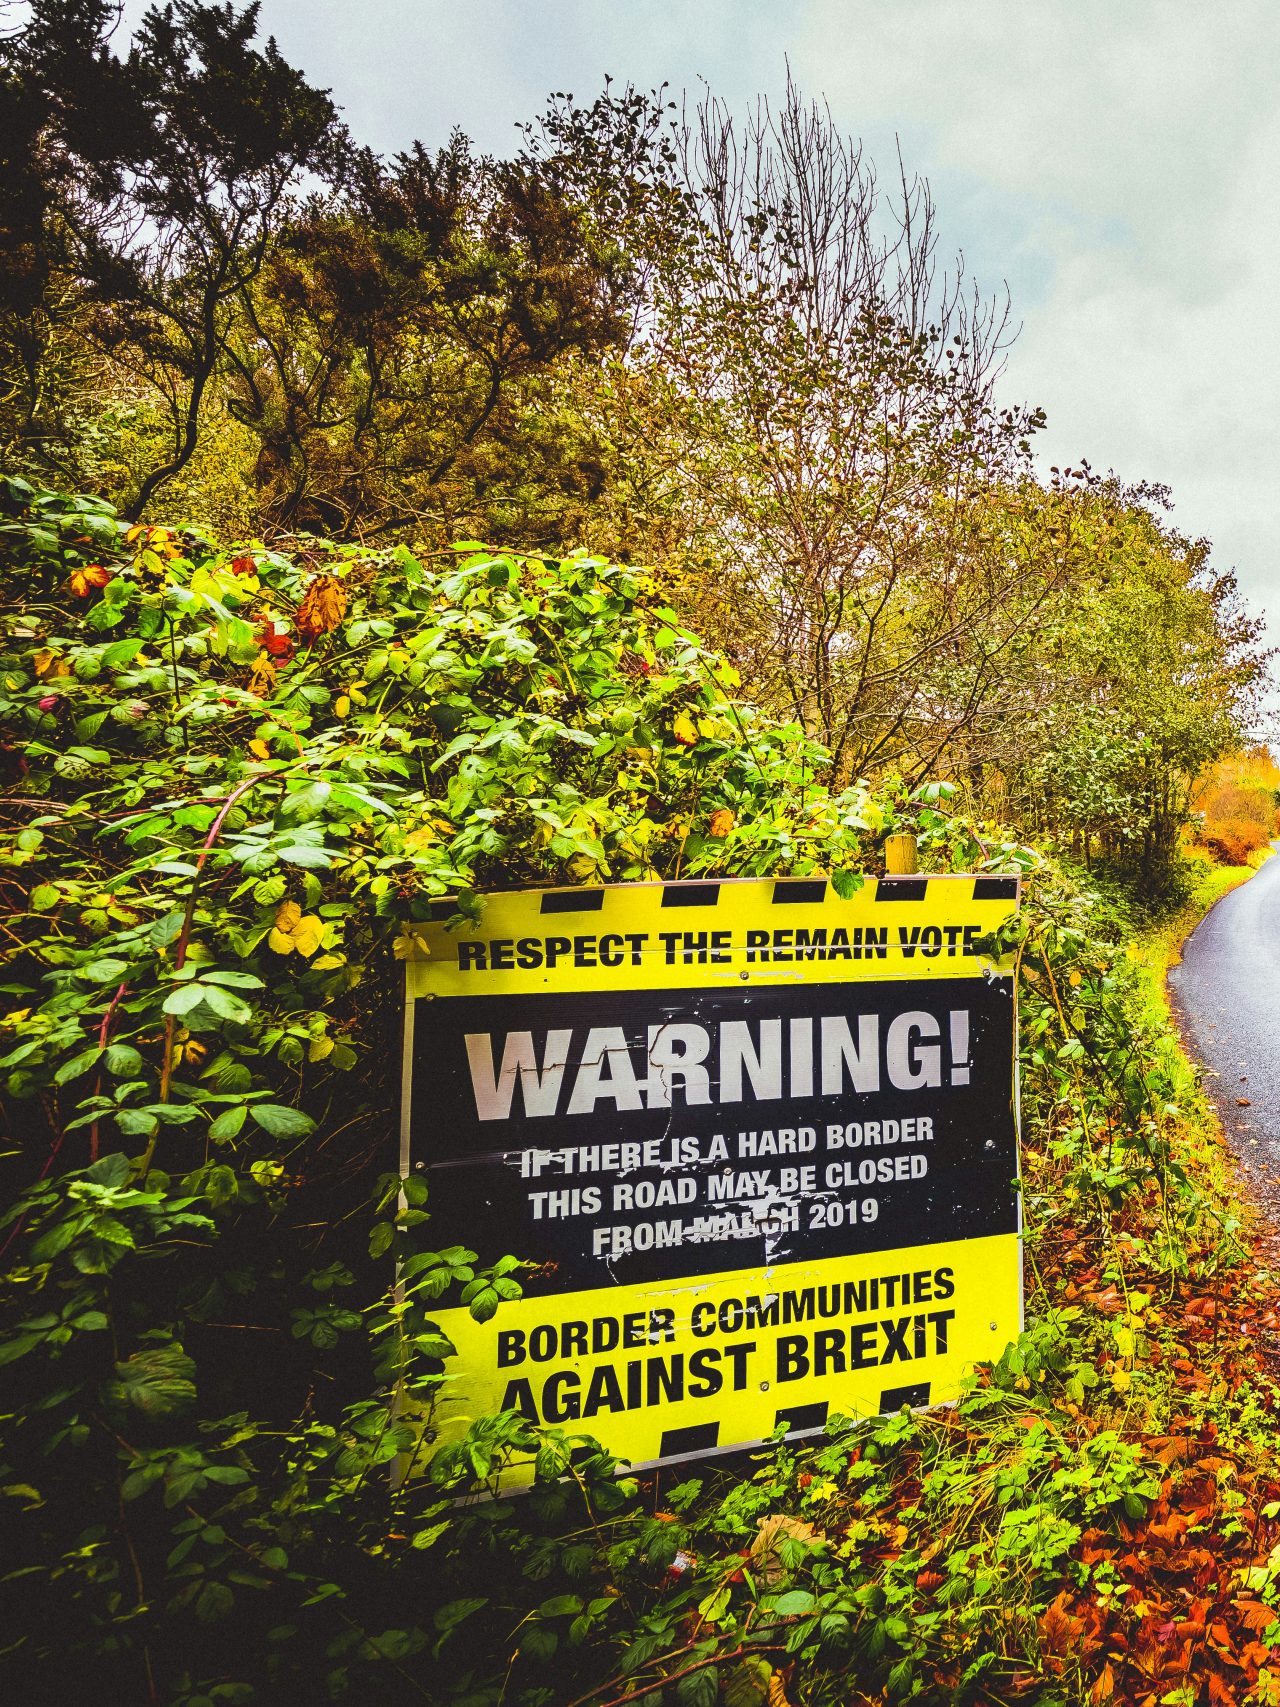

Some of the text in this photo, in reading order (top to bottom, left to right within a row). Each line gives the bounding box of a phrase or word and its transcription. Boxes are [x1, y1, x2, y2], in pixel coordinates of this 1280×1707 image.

[457, 925, 982, 971] RESPECT THE REMAIN VOTE
[464, 1010, 971, 1122] WARNING!
[521, 1117, 934, 1178] IF THERE IS A HARD BORDER
[528, 1154, 928, 1220] THIS ROAD MAY BE CLOSED
[592, 1220, 683, 1257] FROM
[809, 1199, 879, 1231] 2019
[497, 1266, 955, 1368] BORDER COMMUNITIES
[499, 1309, 956, 1428] AGAINST BREXIT
